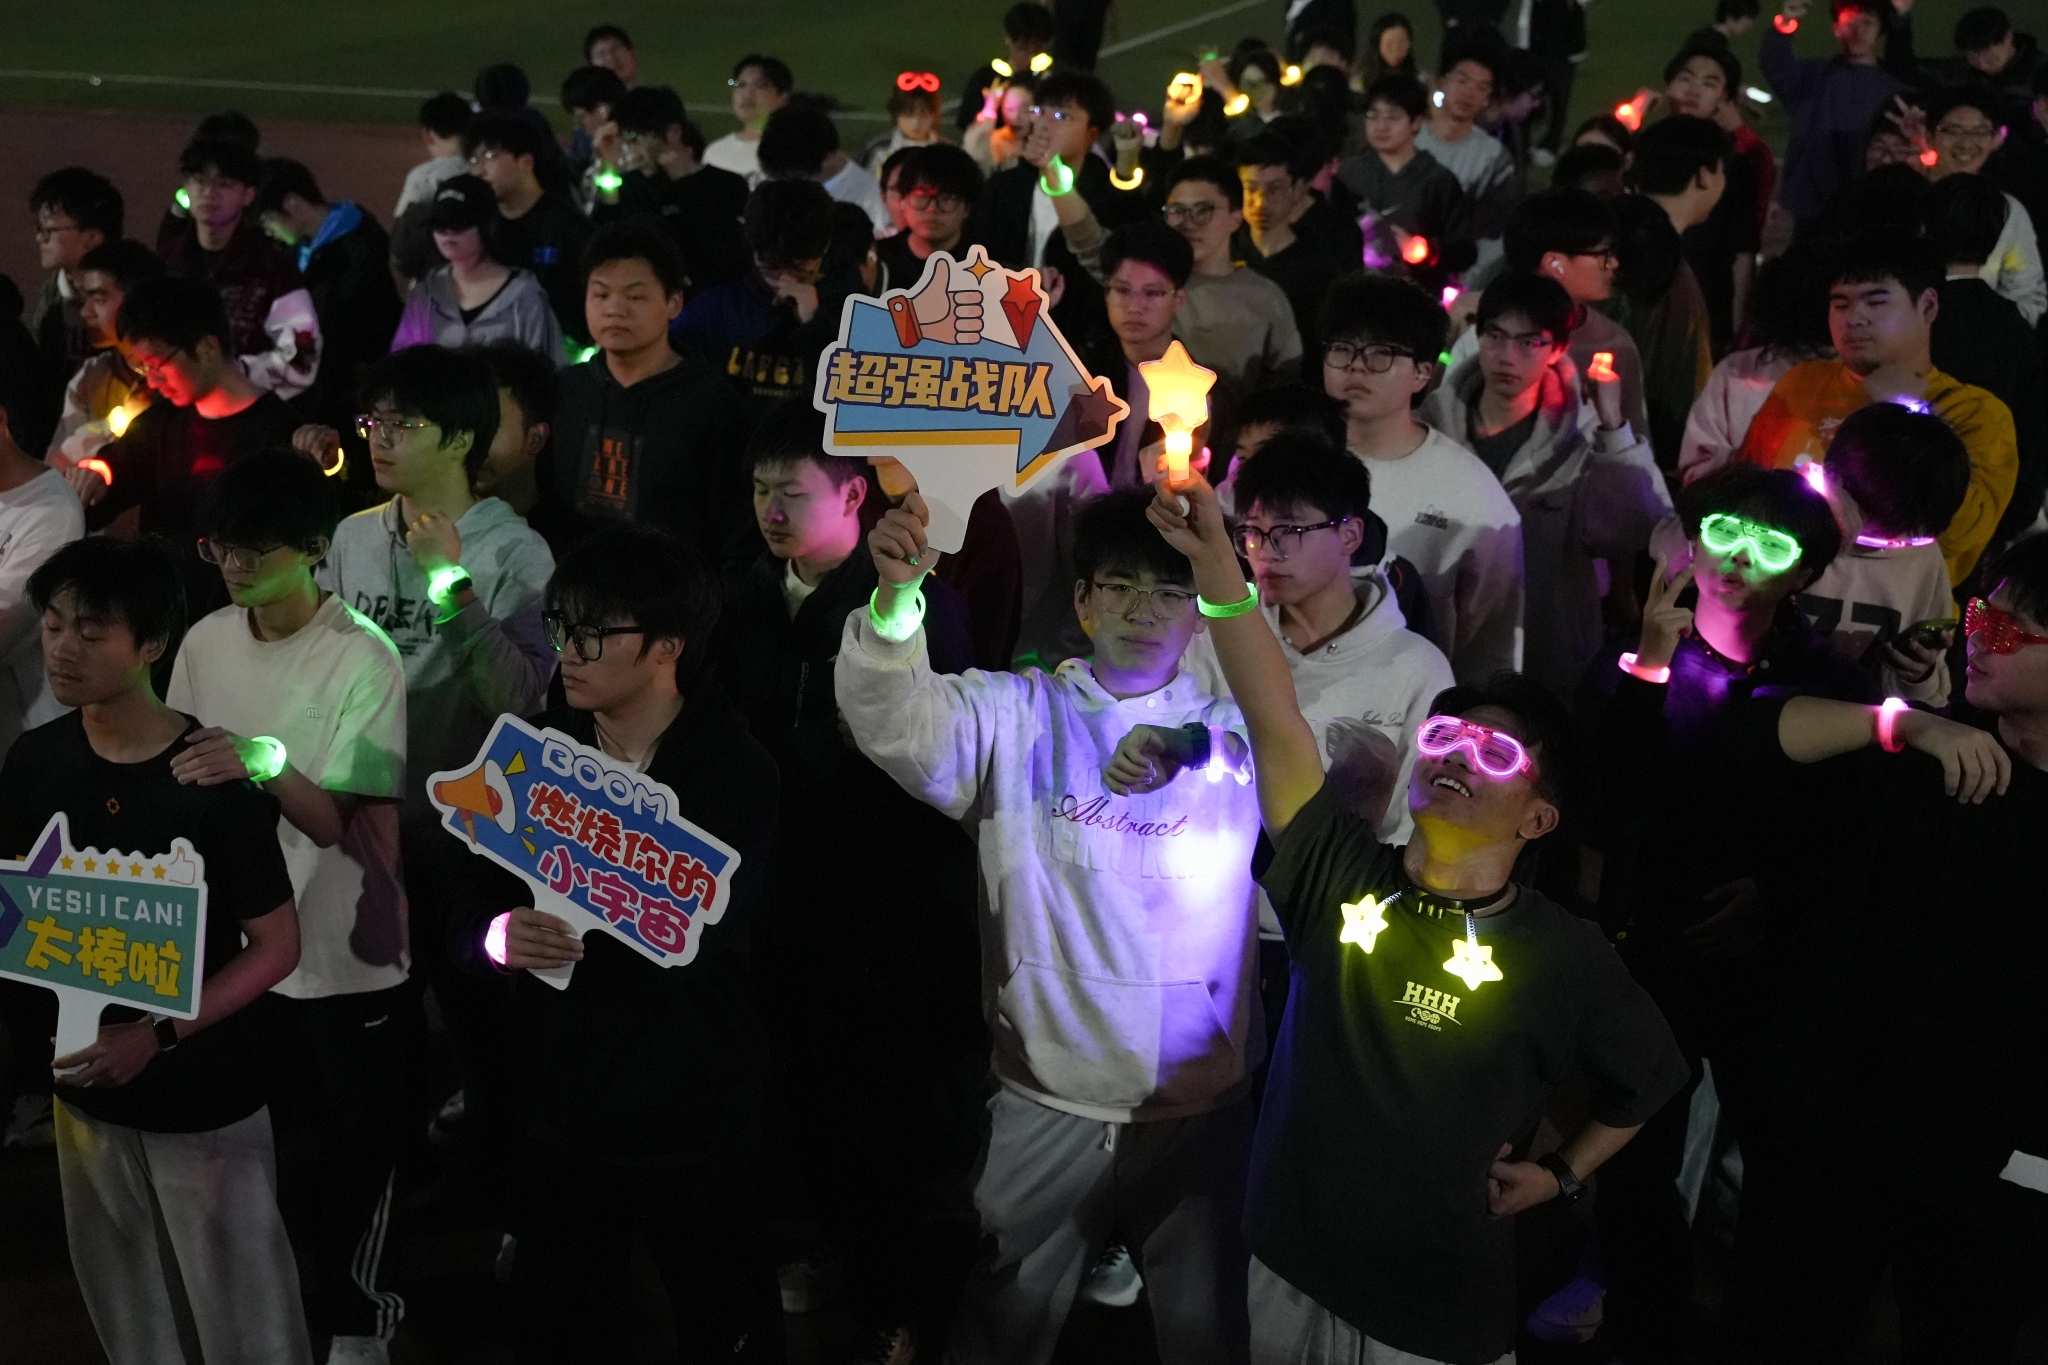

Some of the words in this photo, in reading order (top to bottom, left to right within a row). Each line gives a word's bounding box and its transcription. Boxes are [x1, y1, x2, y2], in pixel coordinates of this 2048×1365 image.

[824, 349, 1055, 417] 超强战队
[541, 737, 668, 825] BOOM
[1052, 794, 1188, 837] Abstract
[528, 783, 717, 912] 燃烧你的
[27, 885, 92, 915] YES!
[100, 893, 106, 917] I
[115, 896, 183, 927] CAN!
[539, 847, 691, 955] 小宇宙
[25, 915, 183, 997] 太棒啦
[1402, 981, 1461, 1018] HHH
